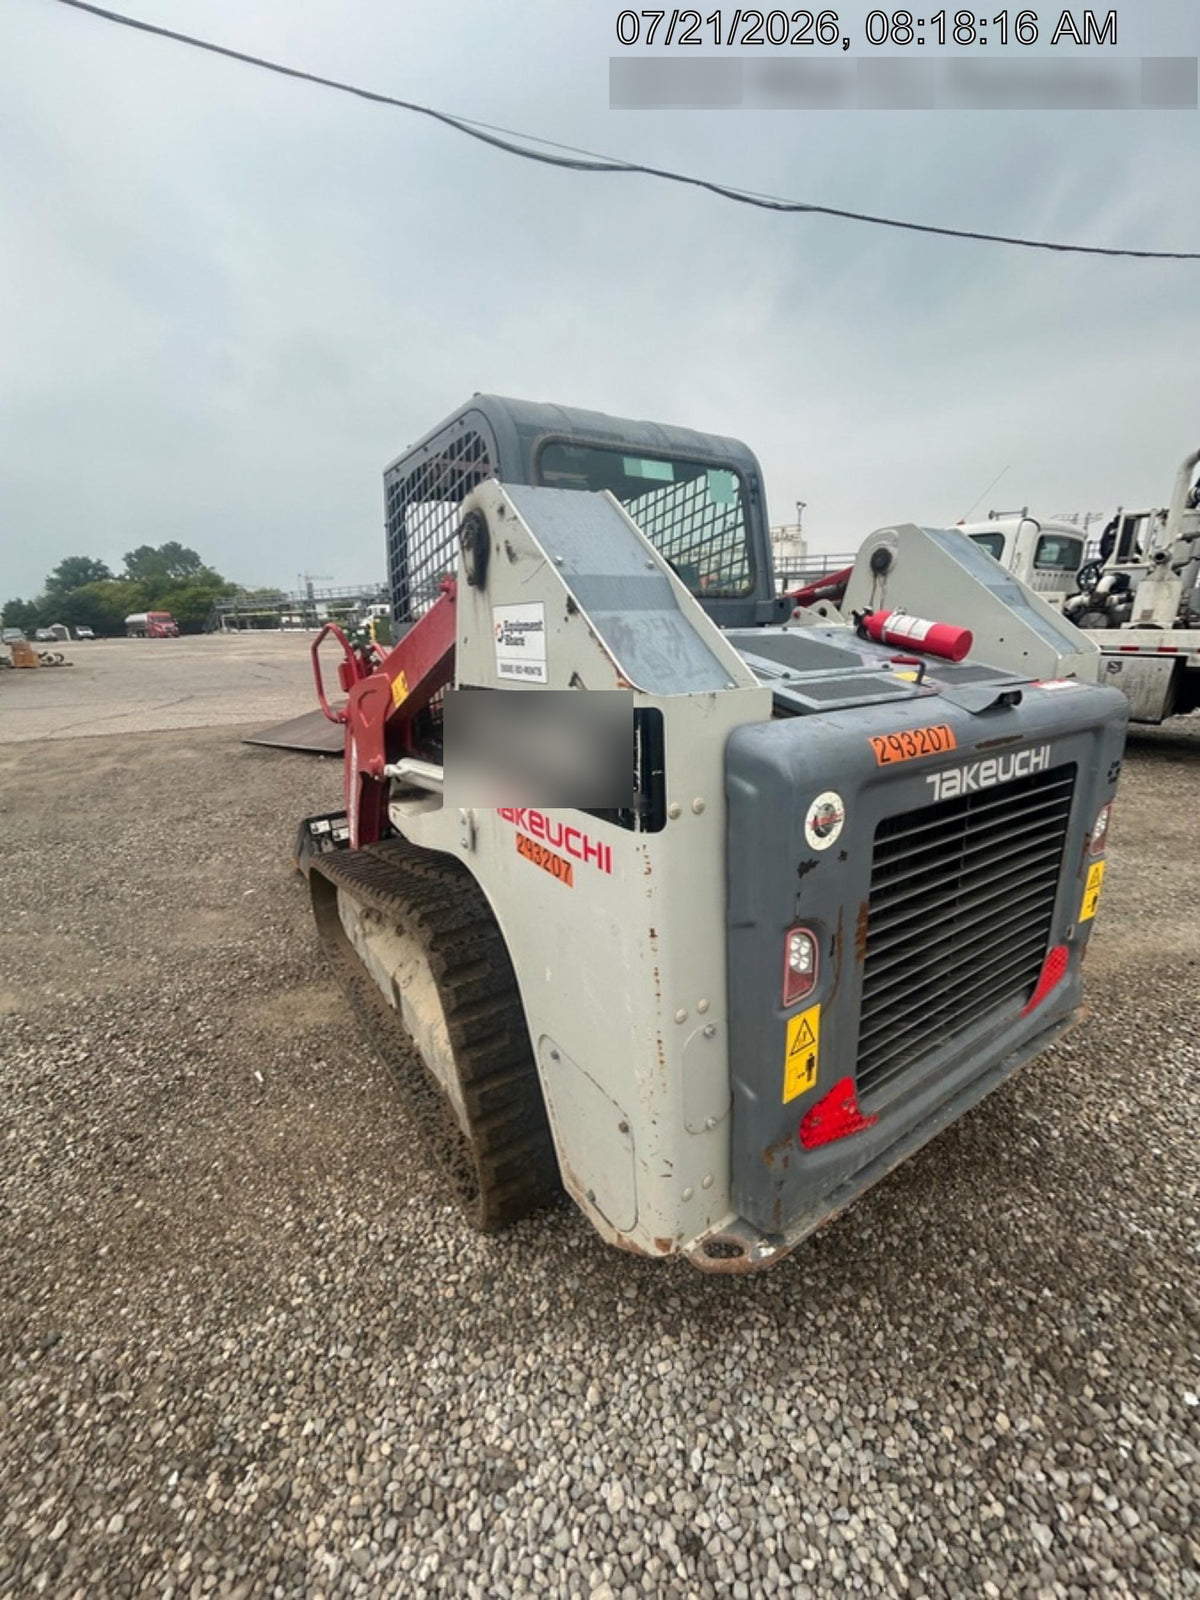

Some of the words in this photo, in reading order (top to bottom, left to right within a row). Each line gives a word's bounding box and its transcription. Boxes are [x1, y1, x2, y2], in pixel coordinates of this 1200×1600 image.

[873, 726, 951, 762] 293207
[926, 745, 1051, 801] TAKEUCHI
[496, 808, 612, 874] AKEUCHI
[517, 832, 571, 884] 293207
